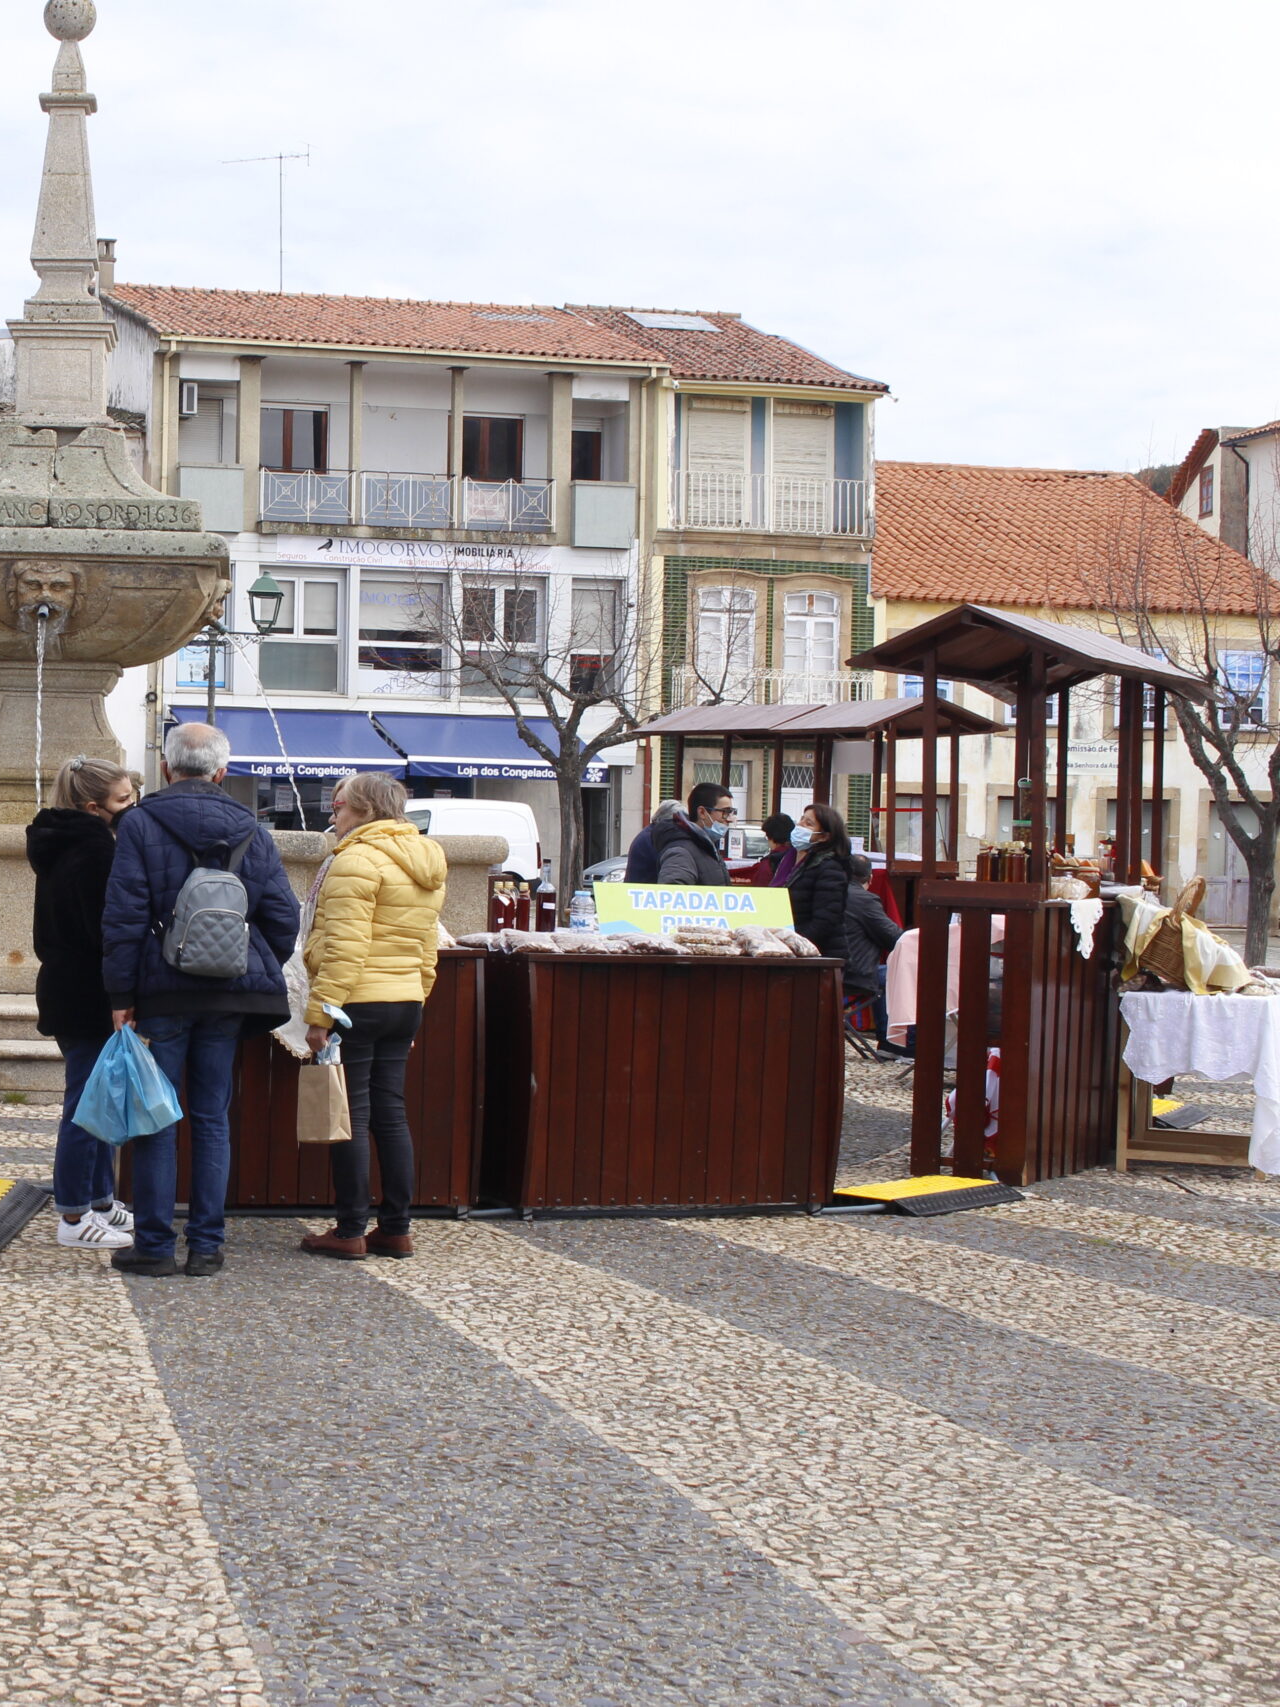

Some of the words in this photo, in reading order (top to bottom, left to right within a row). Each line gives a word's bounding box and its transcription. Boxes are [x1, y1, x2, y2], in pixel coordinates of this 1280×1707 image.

[339, 540, 443, 557] IMOCORVO
[277, 552, 307, 561] Seguros
[324, 554, 365, 564] Construção
[367, 555, 383, 564] Civil
[251, 764, 273, 776] Loja
[276, 765, 294, 775] dos
[297, 765, 357, 777] Congelados
[457, 765, 478, 777] Loja
[481, 766, 499, 776] dos
[629, 890, 719, 911] TAPADA
[723, 893, 755, 912] DA
